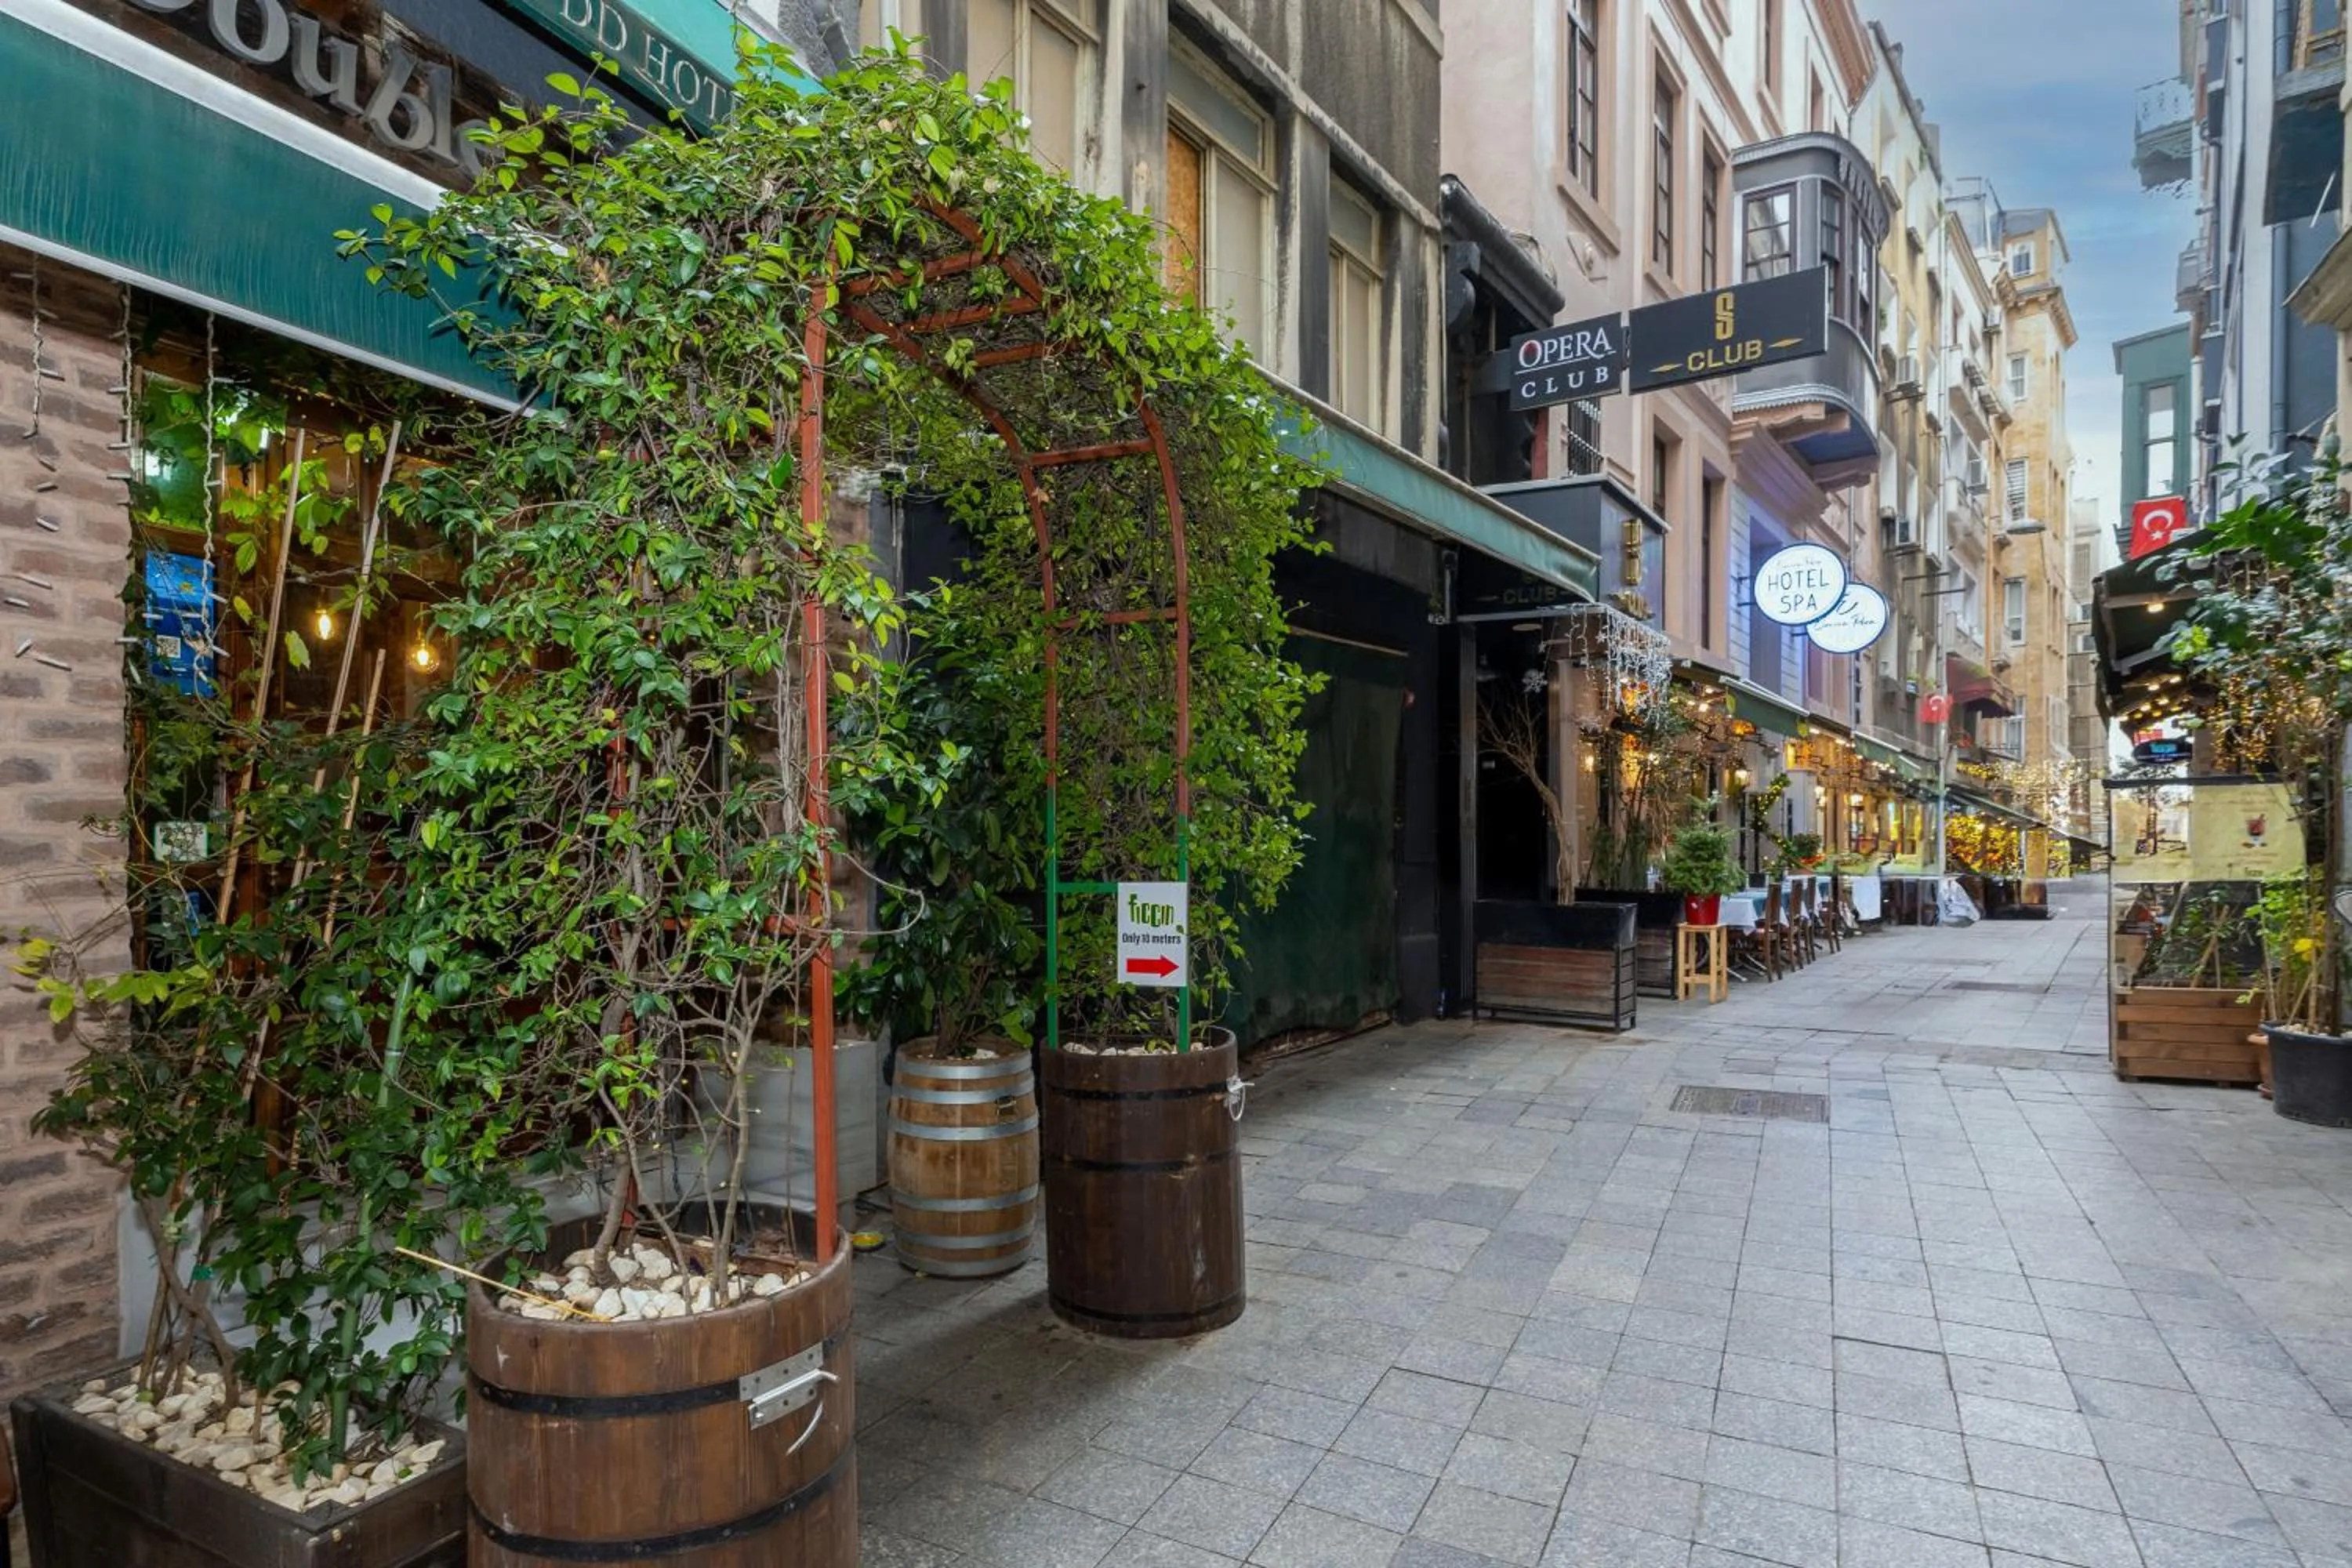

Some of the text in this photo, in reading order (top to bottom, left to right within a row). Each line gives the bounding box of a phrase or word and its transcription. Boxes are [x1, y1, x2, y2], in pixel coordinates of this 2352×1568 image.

[130, 0, 506, 177] ouble
[1715, 291, 1736, 341] S
[1519, 326, 1613, 368] OPERA
[1687, 339, 1763, 372] CLUB
[1521, 365, 1609, 398] CLUB
[1502, 585, 1557, 604] CLUB
[1767, 568, 1830, 592] HOTEL
[1780, 593, 1818, 614] SPA
[1122, 932, 1141, 946] Only
[1152, 934, 1181, 945] meters
